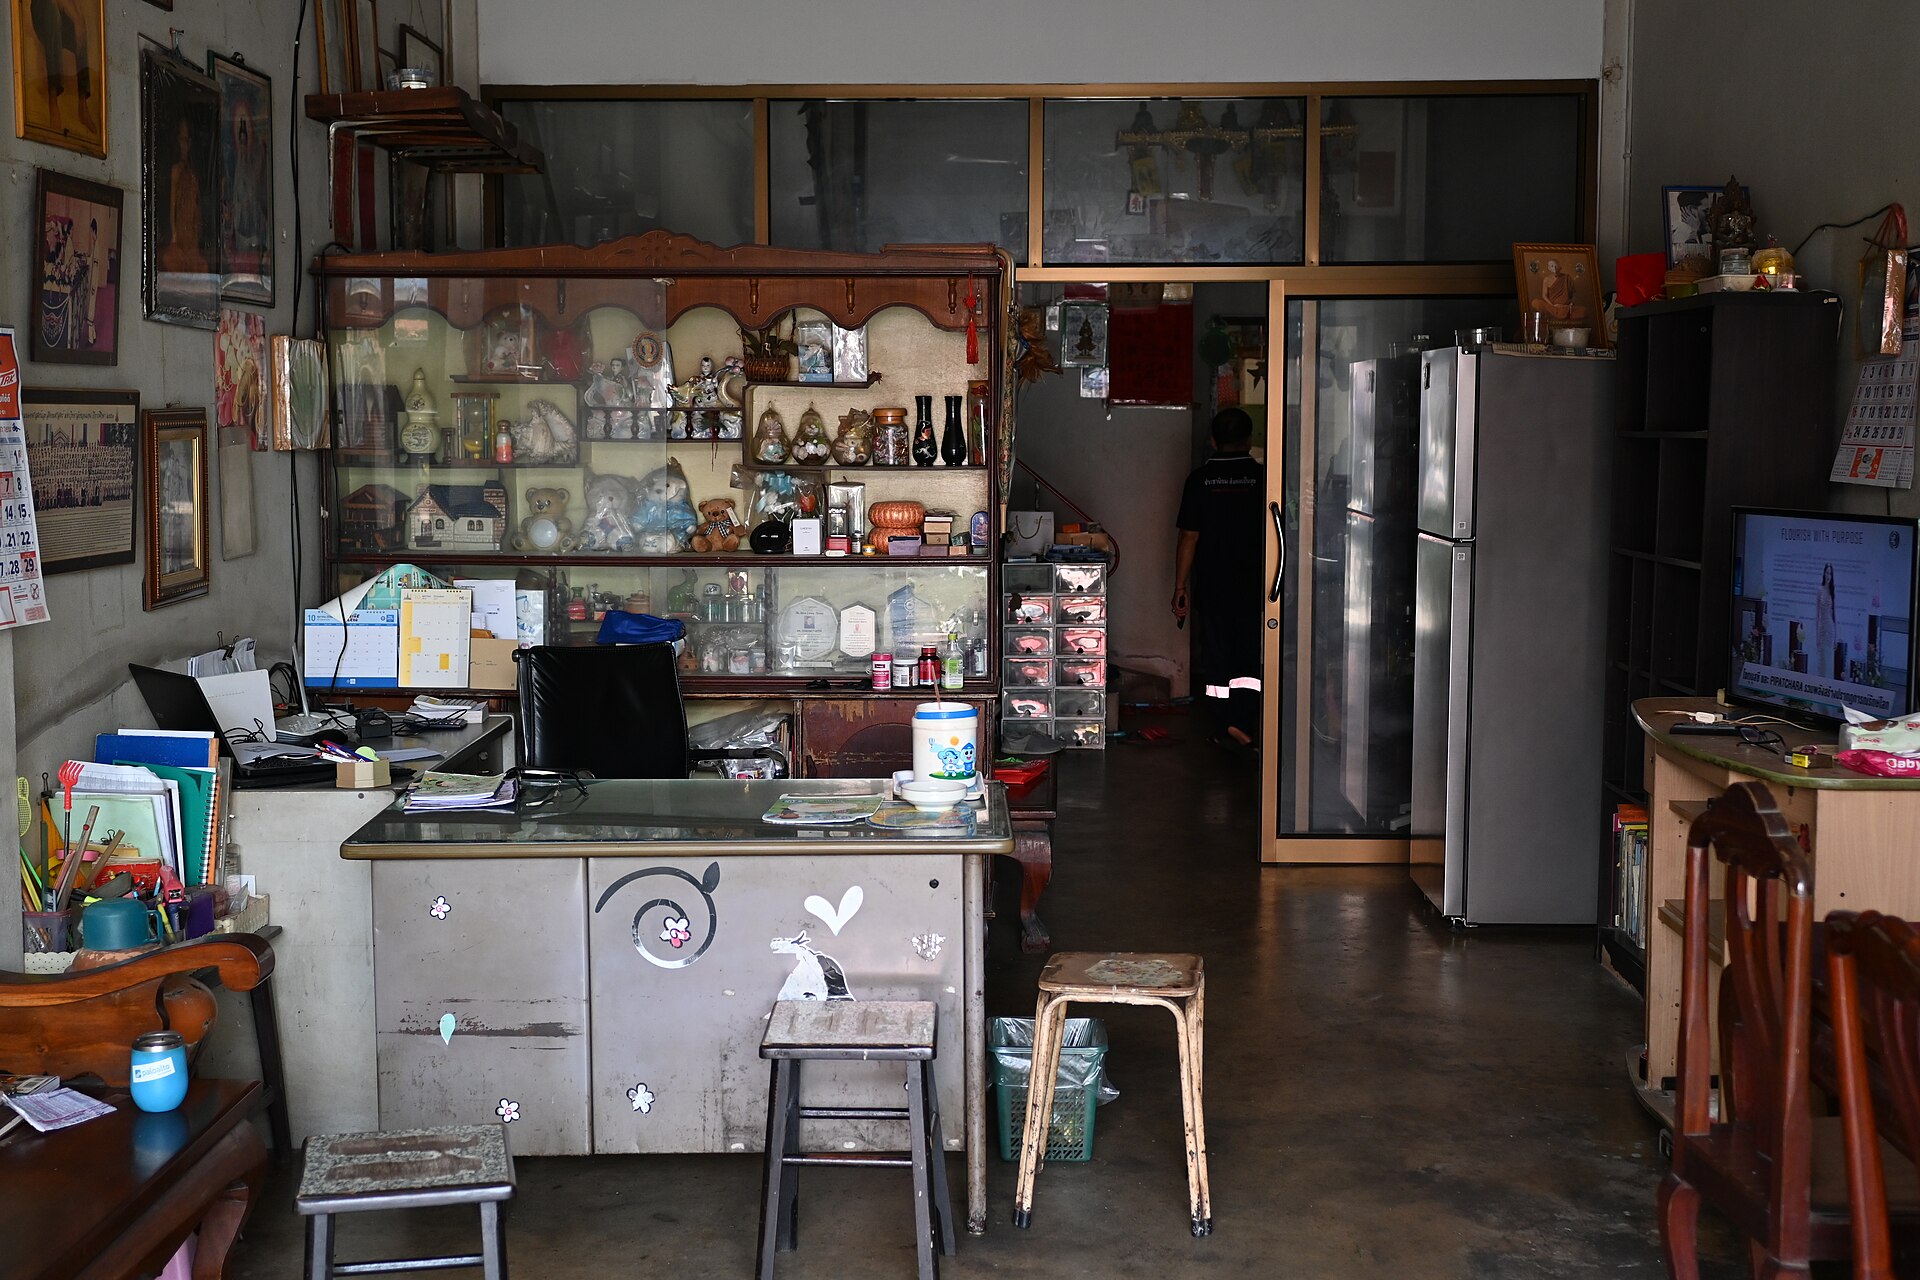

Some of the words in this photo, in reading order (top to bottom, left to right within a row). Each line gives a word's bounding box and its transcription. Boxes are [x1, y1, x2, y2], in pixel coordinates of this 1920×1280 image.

[1862, 366, 1867, 379] 2
[1869, 366, 1875, 378] 3
[1900, 364, 1905, 377] 7
[1864, 386, 1871, 398] 10
[1873, 386, 1879, 398] 11
[1888, 385, 1894, 398] 13
[1897, 385, 1903, 398] 14
[1905, 385, 1912, 397] 15
[1859, 406, 1867, 418] 17
[1868, 406, 1876, 418] 18
[1884, 406, 1891, 418] 20
[1892, 406, 1899, 418] 21
[1900, 405, 1908, 418] 22
[1853, 426, 1861, 438] 24
[1862, 426, 1871, 439] 25
[1871, 426, 1880, 439] 26
[1880, 427, 1888, 439] 27
[1888, 427, 1896, 439] 28
[1896, 427, 1904, 439] 29
[5, 478, 10, 492] 7
[17, 477, 22, 491] 8
[5, 505, 14, 519] 14
[18, 504, 27, 518] 15
[7, 532, 17, 547] 21
[20, 531, 31, 545] 22
[1781, 528, 1811, 541] FLOURISH
[1813, 529, 1830, 543] WITH
[1832, 530, 1863, 545] PURPOSE
[10, 560, 20, 575] 28
[24, 558, 34, 573] 29
[308, 614, 316, 622] 10
[1770, 676, 1803, 692] PIPATCHARA
